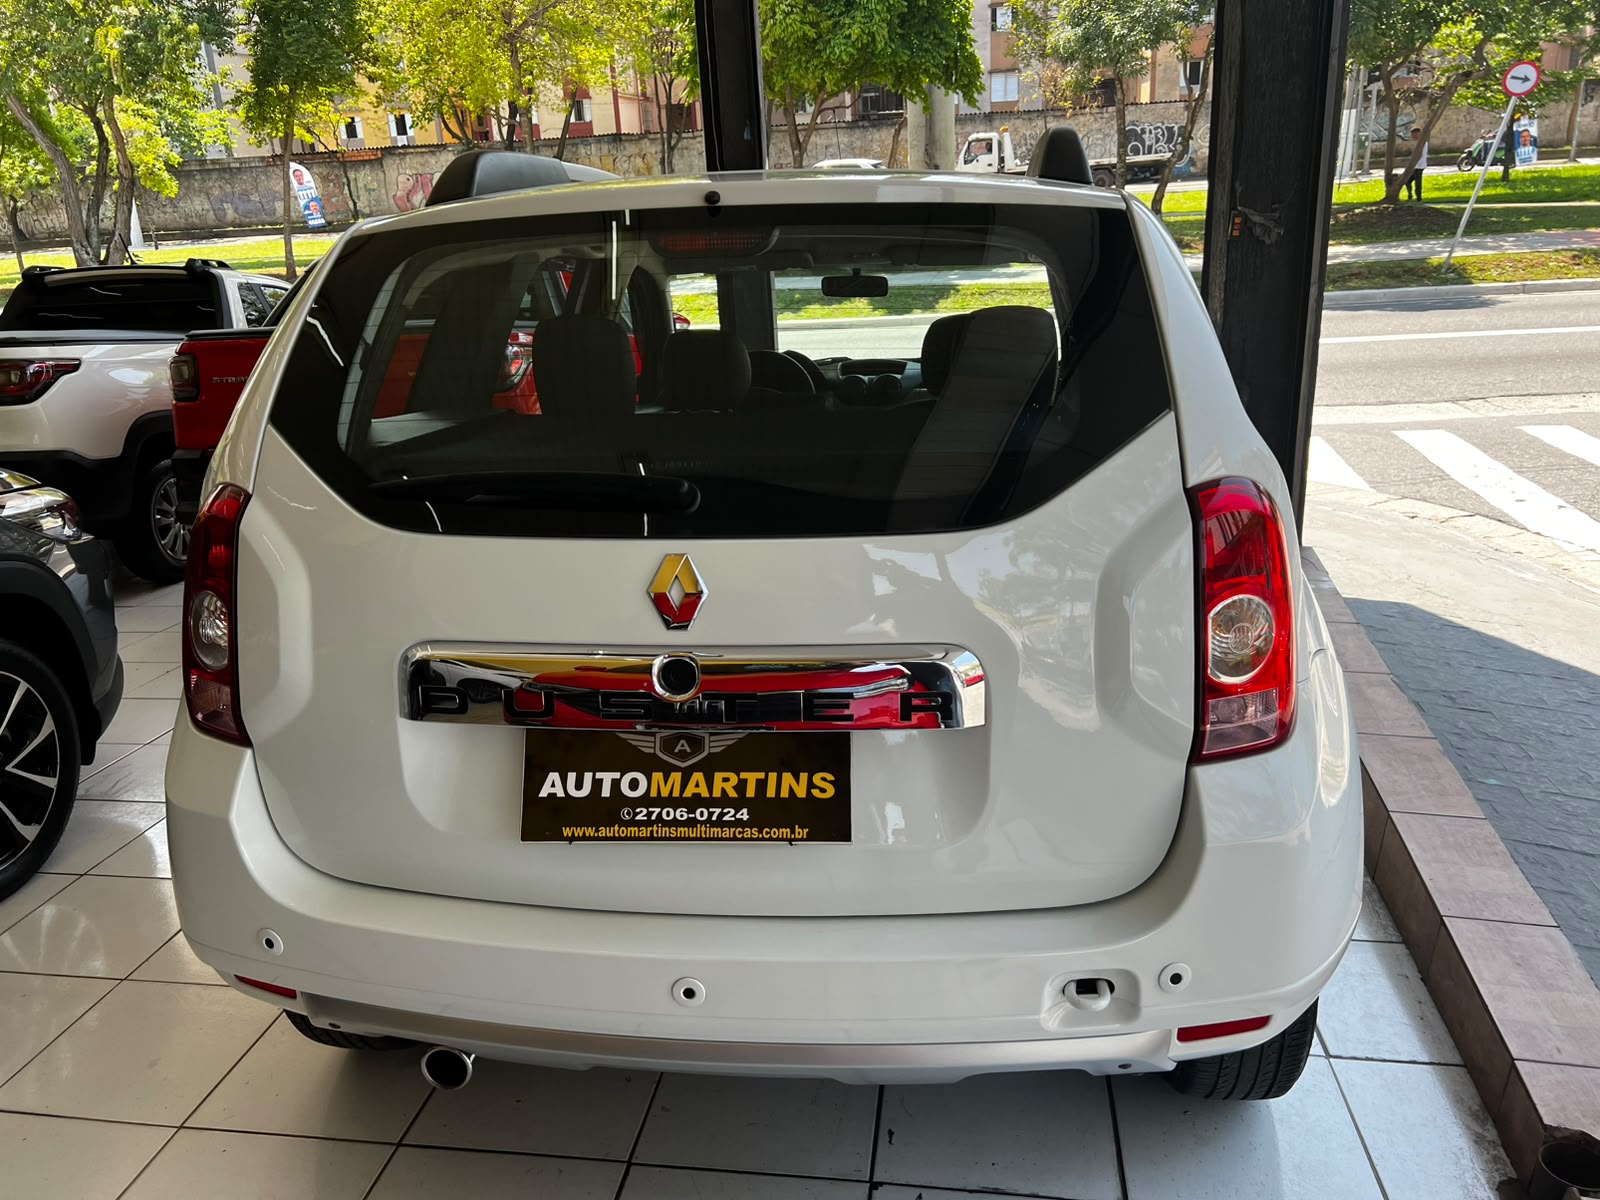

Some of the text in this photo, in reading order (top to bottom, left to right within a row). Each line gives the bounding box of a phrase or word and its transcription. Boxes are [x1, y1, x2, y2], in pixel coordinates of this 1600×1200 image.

[419, 685, 953, 723] DUSTER
[674, 739, 692, 753] A
[538, 771, 836, 799] AUTOMARTINS
[634, 807, 750, 821] 2706-0724
[561, 823, 809, 839] www.automartinsmultimarcas.com.br
